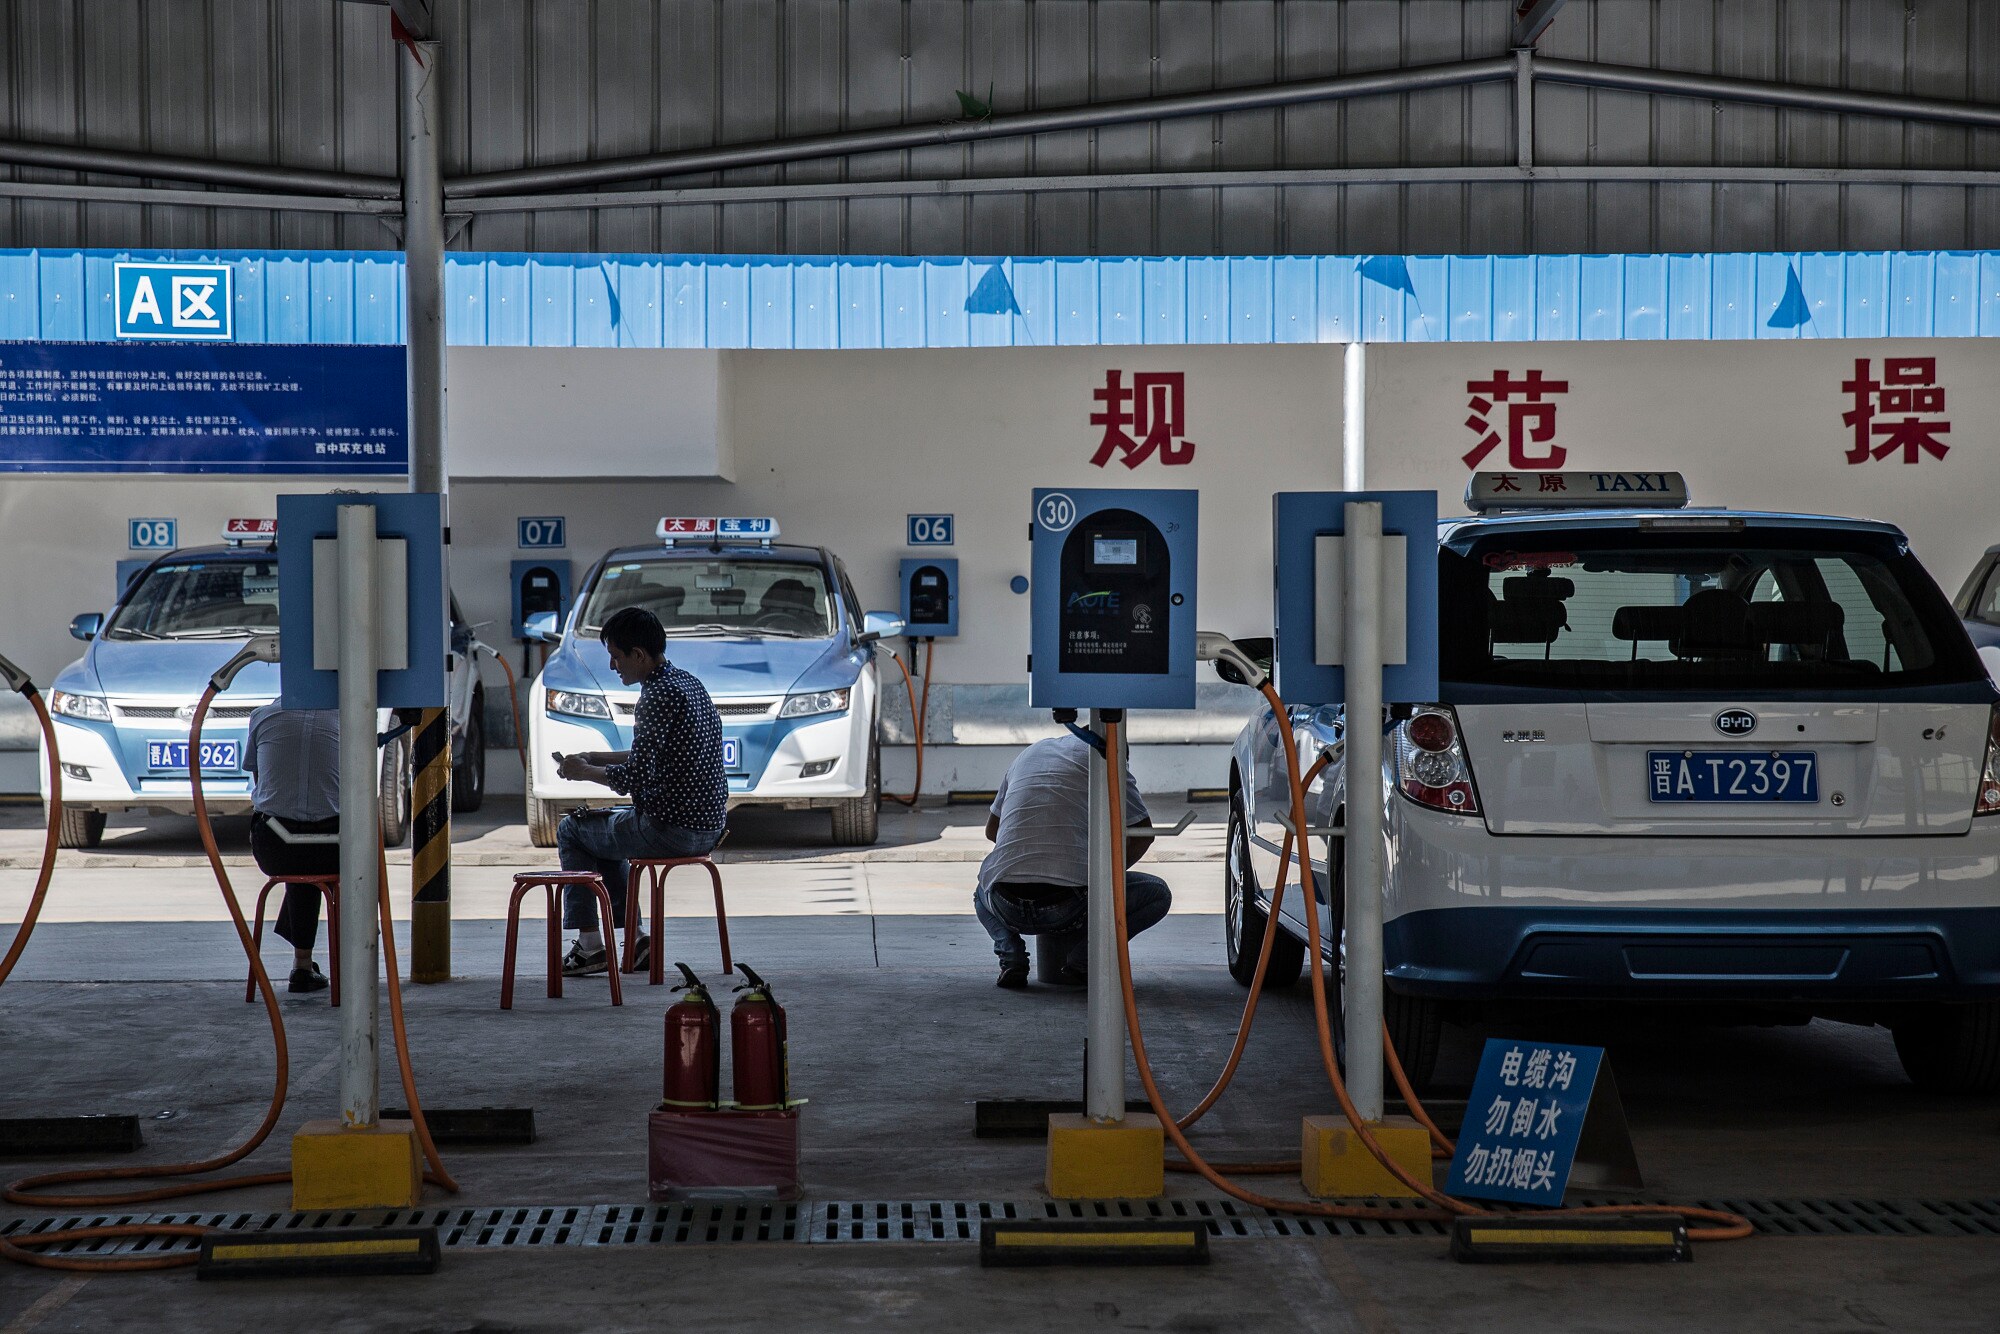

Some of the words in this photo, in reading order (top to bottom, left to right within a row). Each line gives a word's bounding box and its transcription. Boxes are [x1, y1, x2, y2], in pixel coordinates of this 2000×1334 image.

[126, 275, 220, 328] A区
[1090, 369, 1196, 468] 规
[1462, 369, 1570, 469] 范
[1842, 357, 1952, 464] 操
[315, 442, 387, 455] 西中环充电站
[1491, 473, 1568, 493] 太原
[1589, 473, 1670, 492] TAXI
[1045, 500, 1069, 525] 30
[135, 522, 170, 546] 08
[231, 518, 275, 533] 太原
[526, 521, 558, 544] 07
[668, 518, 712, 532] 太原
[724, 518, 768, 532] 宝利
[915, 518, 946, 541] 06
[1166, 522, 1181, 534] 30
[1720, 717, 1752, 729] BYD
[1922, 725, 1946, 741] e6
[150, 745, 235, 767] 晋A·T962
[1653, 759, 1813, 796] 晋A·T2397
[1500, 1046, 1577, 1091] 电缆沟
[1485, 1095, 1563, 1140] 勿倒水
[1464, 1143, 1556, 1192] 勿扔烟头
